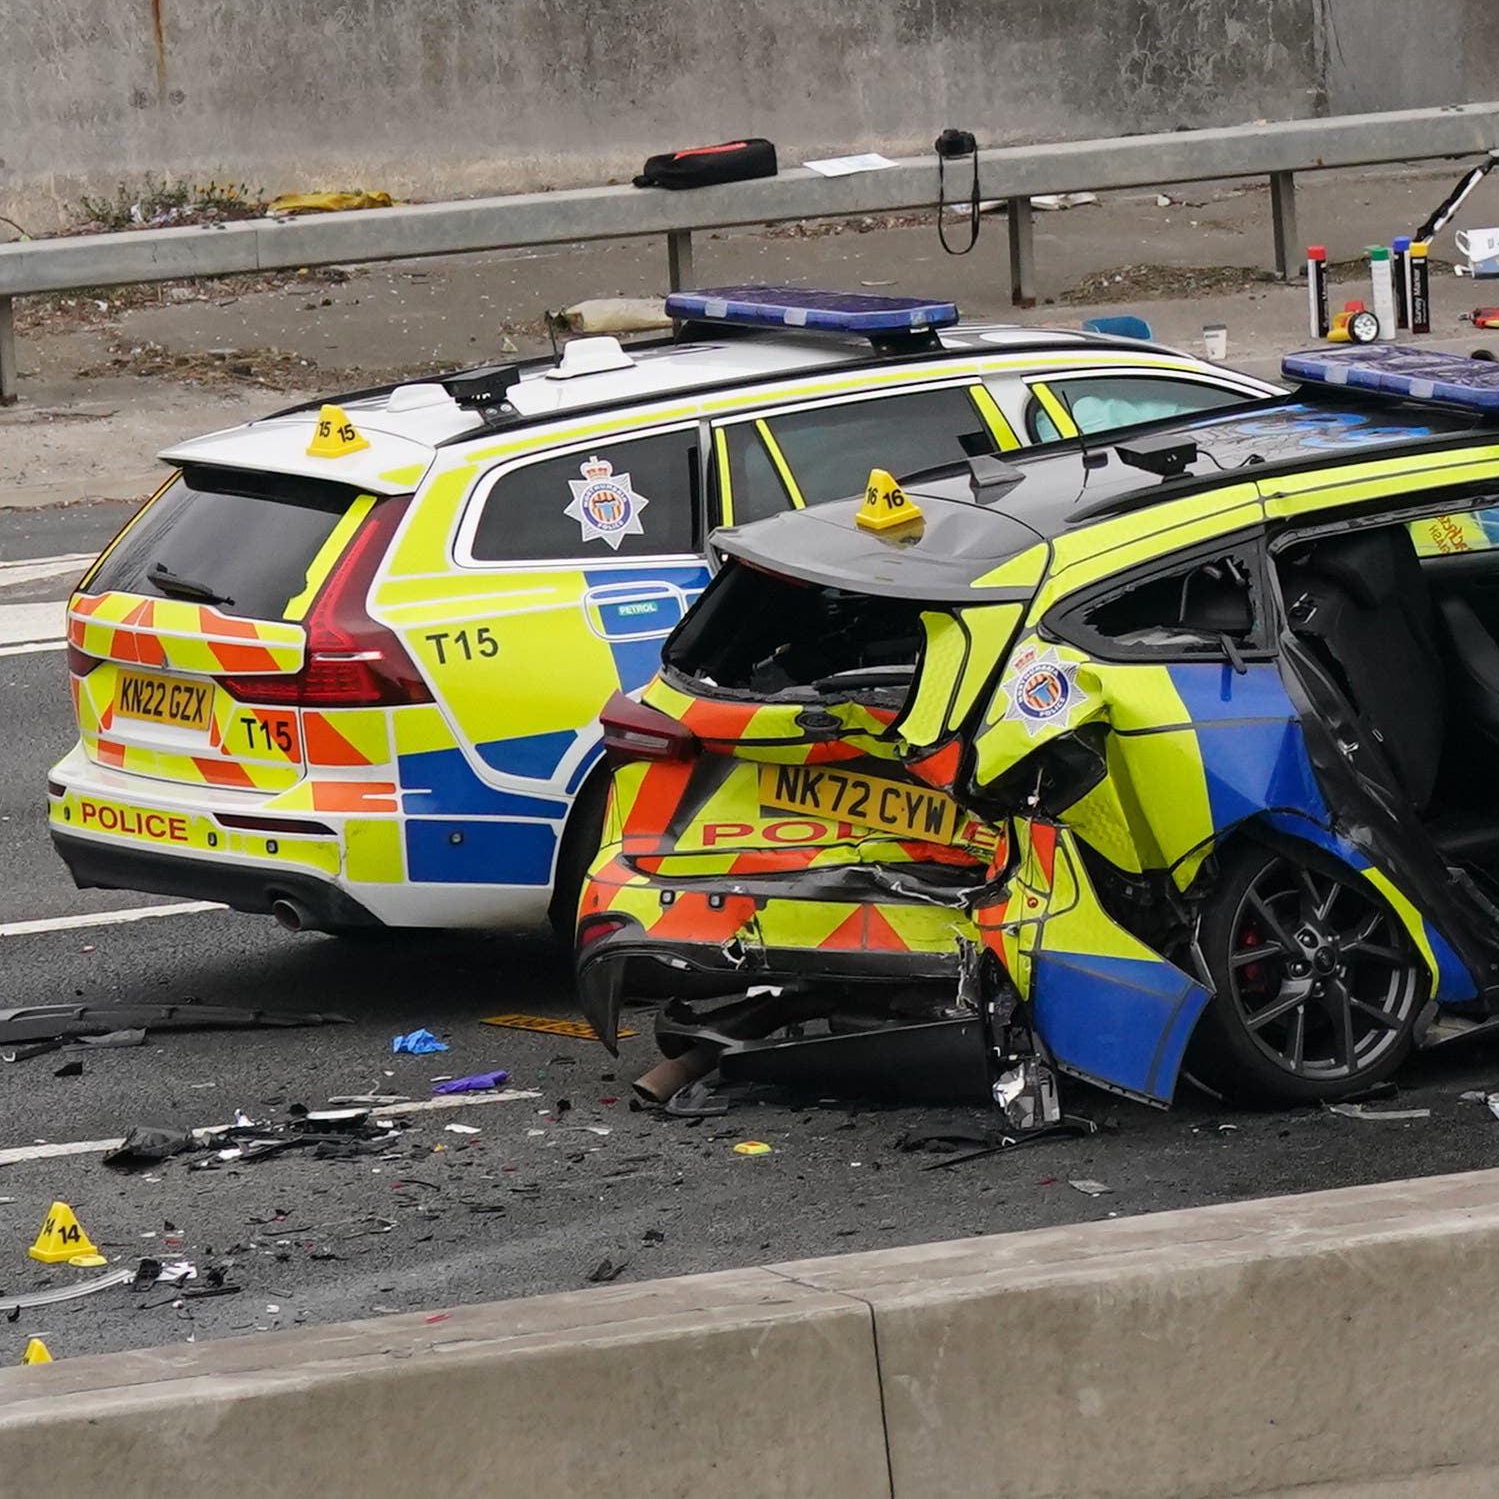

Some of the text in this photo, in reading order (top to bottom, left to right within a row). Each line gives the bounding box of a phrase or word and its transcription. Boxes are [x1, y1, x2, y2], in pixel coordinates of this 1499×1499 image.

[319, 421, 332, 438] 15
[336, 423, 356, 443] 15
[867, 486, 879, 506] 16
[882, 488, 905, 510] 16
[619, 603, 657, 616] PETROL
[425, 627, 499, 665] T15
[120, 676, 207, 724] KN22 GZX
[240, 717, 292, 752] T15
[775, 764, 946, 836] NK72 CYW
[81, 801, 189, 842] POLICE
[58, 1224, 81, 1244] 14
